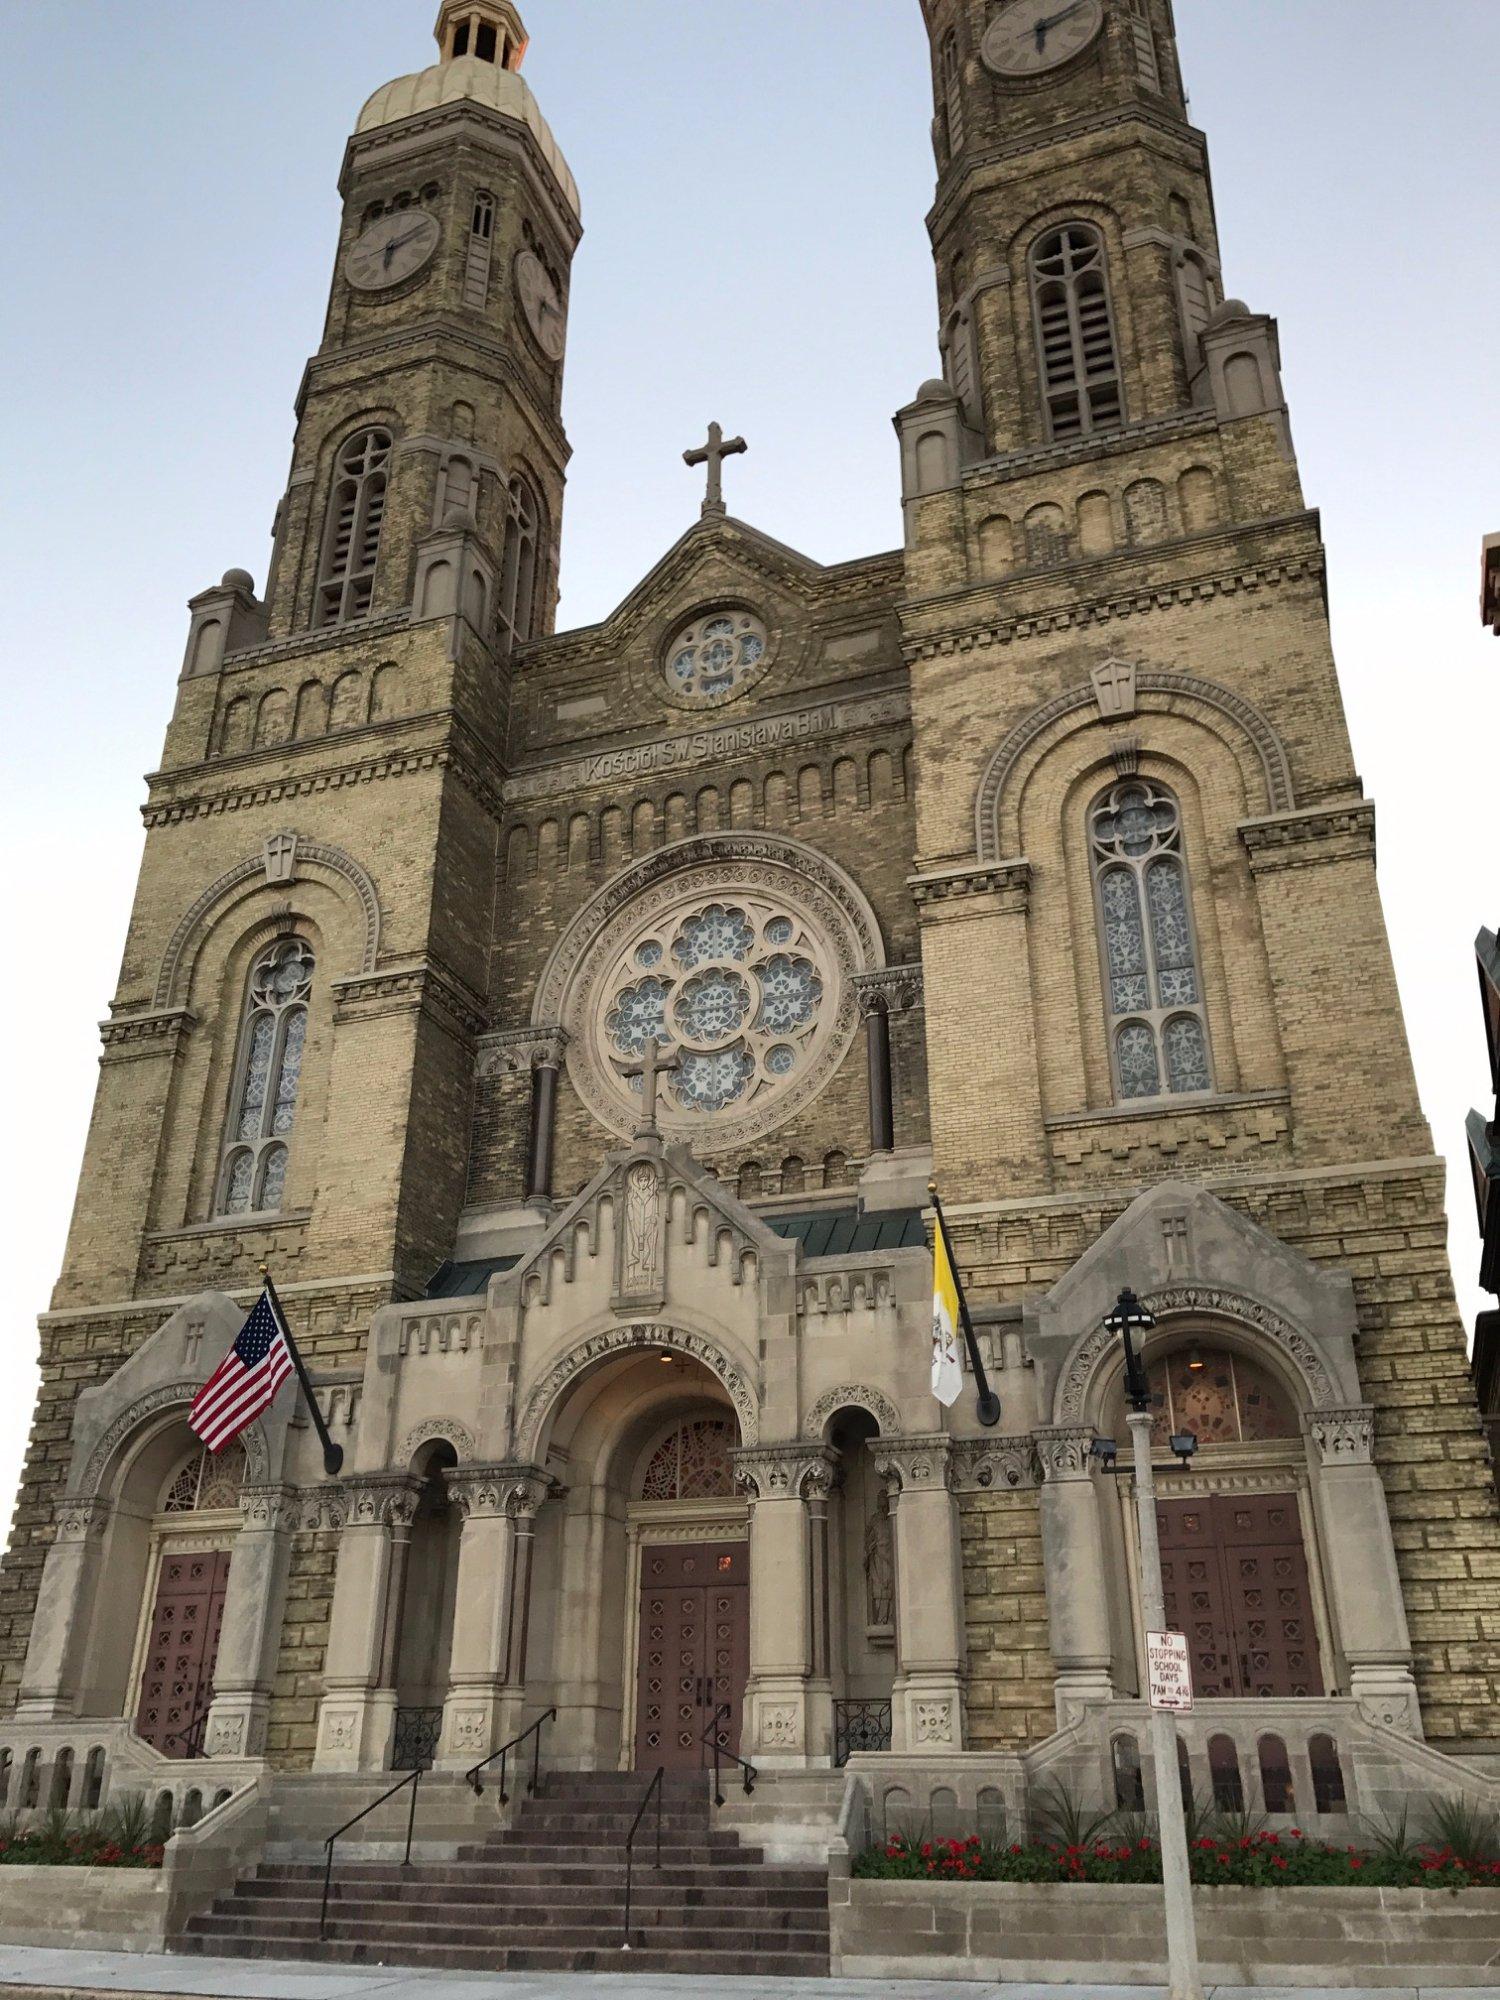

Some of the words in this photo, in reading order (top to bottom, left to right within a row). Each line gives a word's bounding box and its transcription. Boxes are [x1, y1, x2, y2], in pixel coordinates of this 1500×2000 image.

[1160, 1635, 1173, 1646] NO
[1149, 1648, 1186, 1660] STOPPING
[1154, 1661, 1182, 1672] SCHOOL
[1160, 1672, 1179, 1683] DAYS
